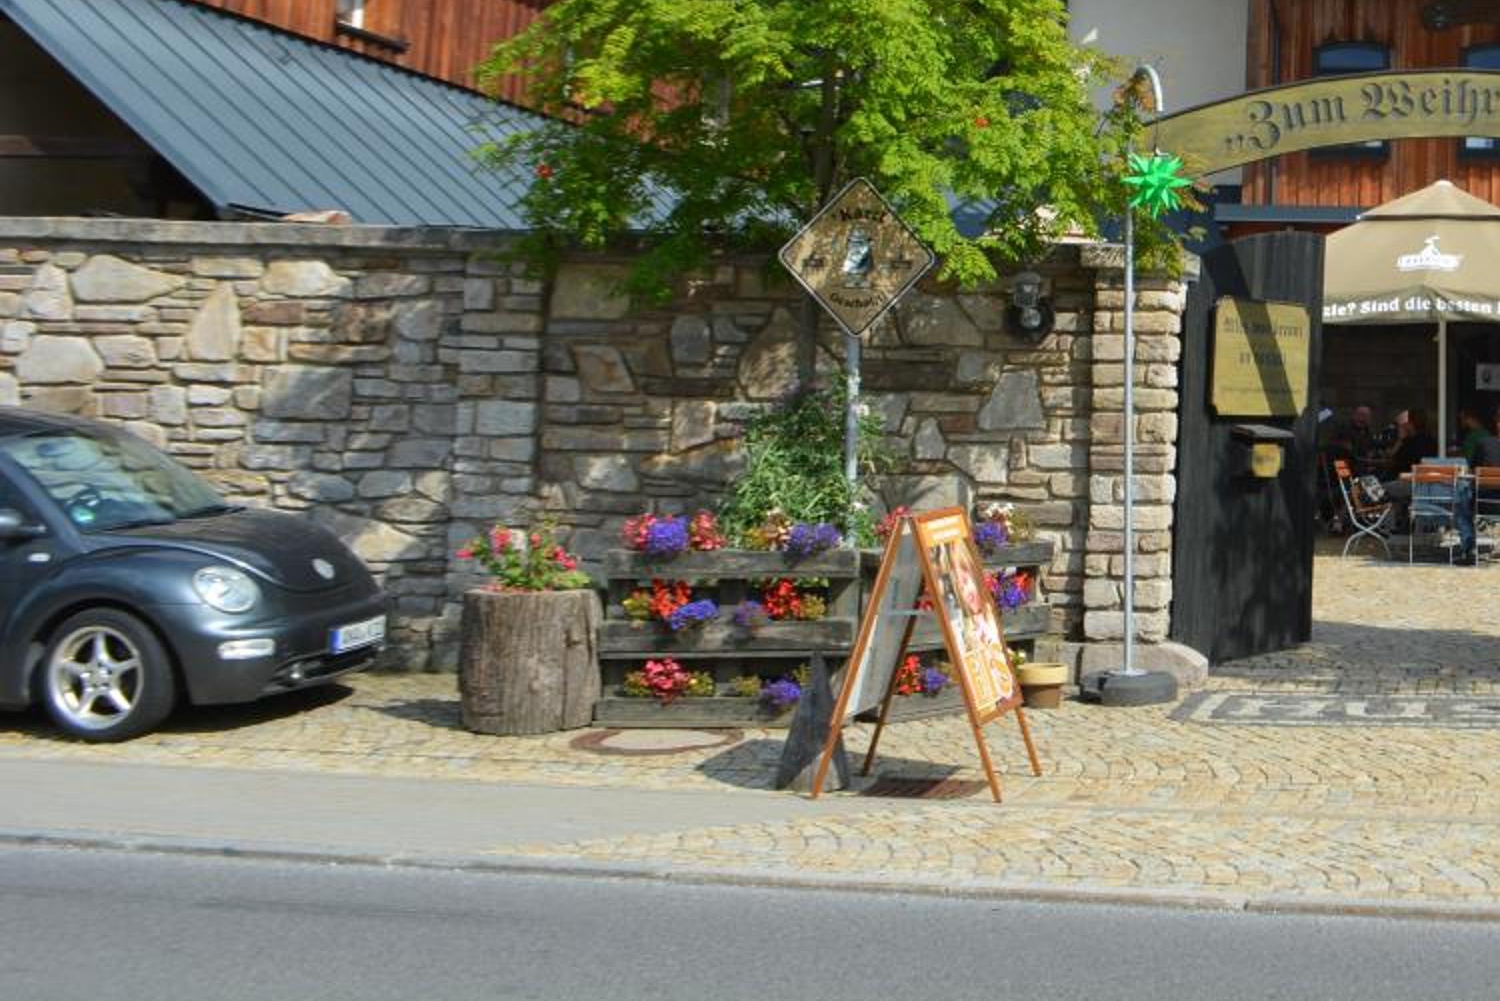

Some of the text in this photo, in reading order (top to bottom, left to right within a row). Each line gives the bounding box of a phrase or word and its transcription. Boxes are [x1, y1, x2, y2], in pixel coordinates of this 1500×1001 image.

[1322, 301, 1358, 318] zle?
[1359, 296, 1400, 315] Sind
[1404, 295, 1434, 312] die
[1436, 296, 1493, 315] besten
